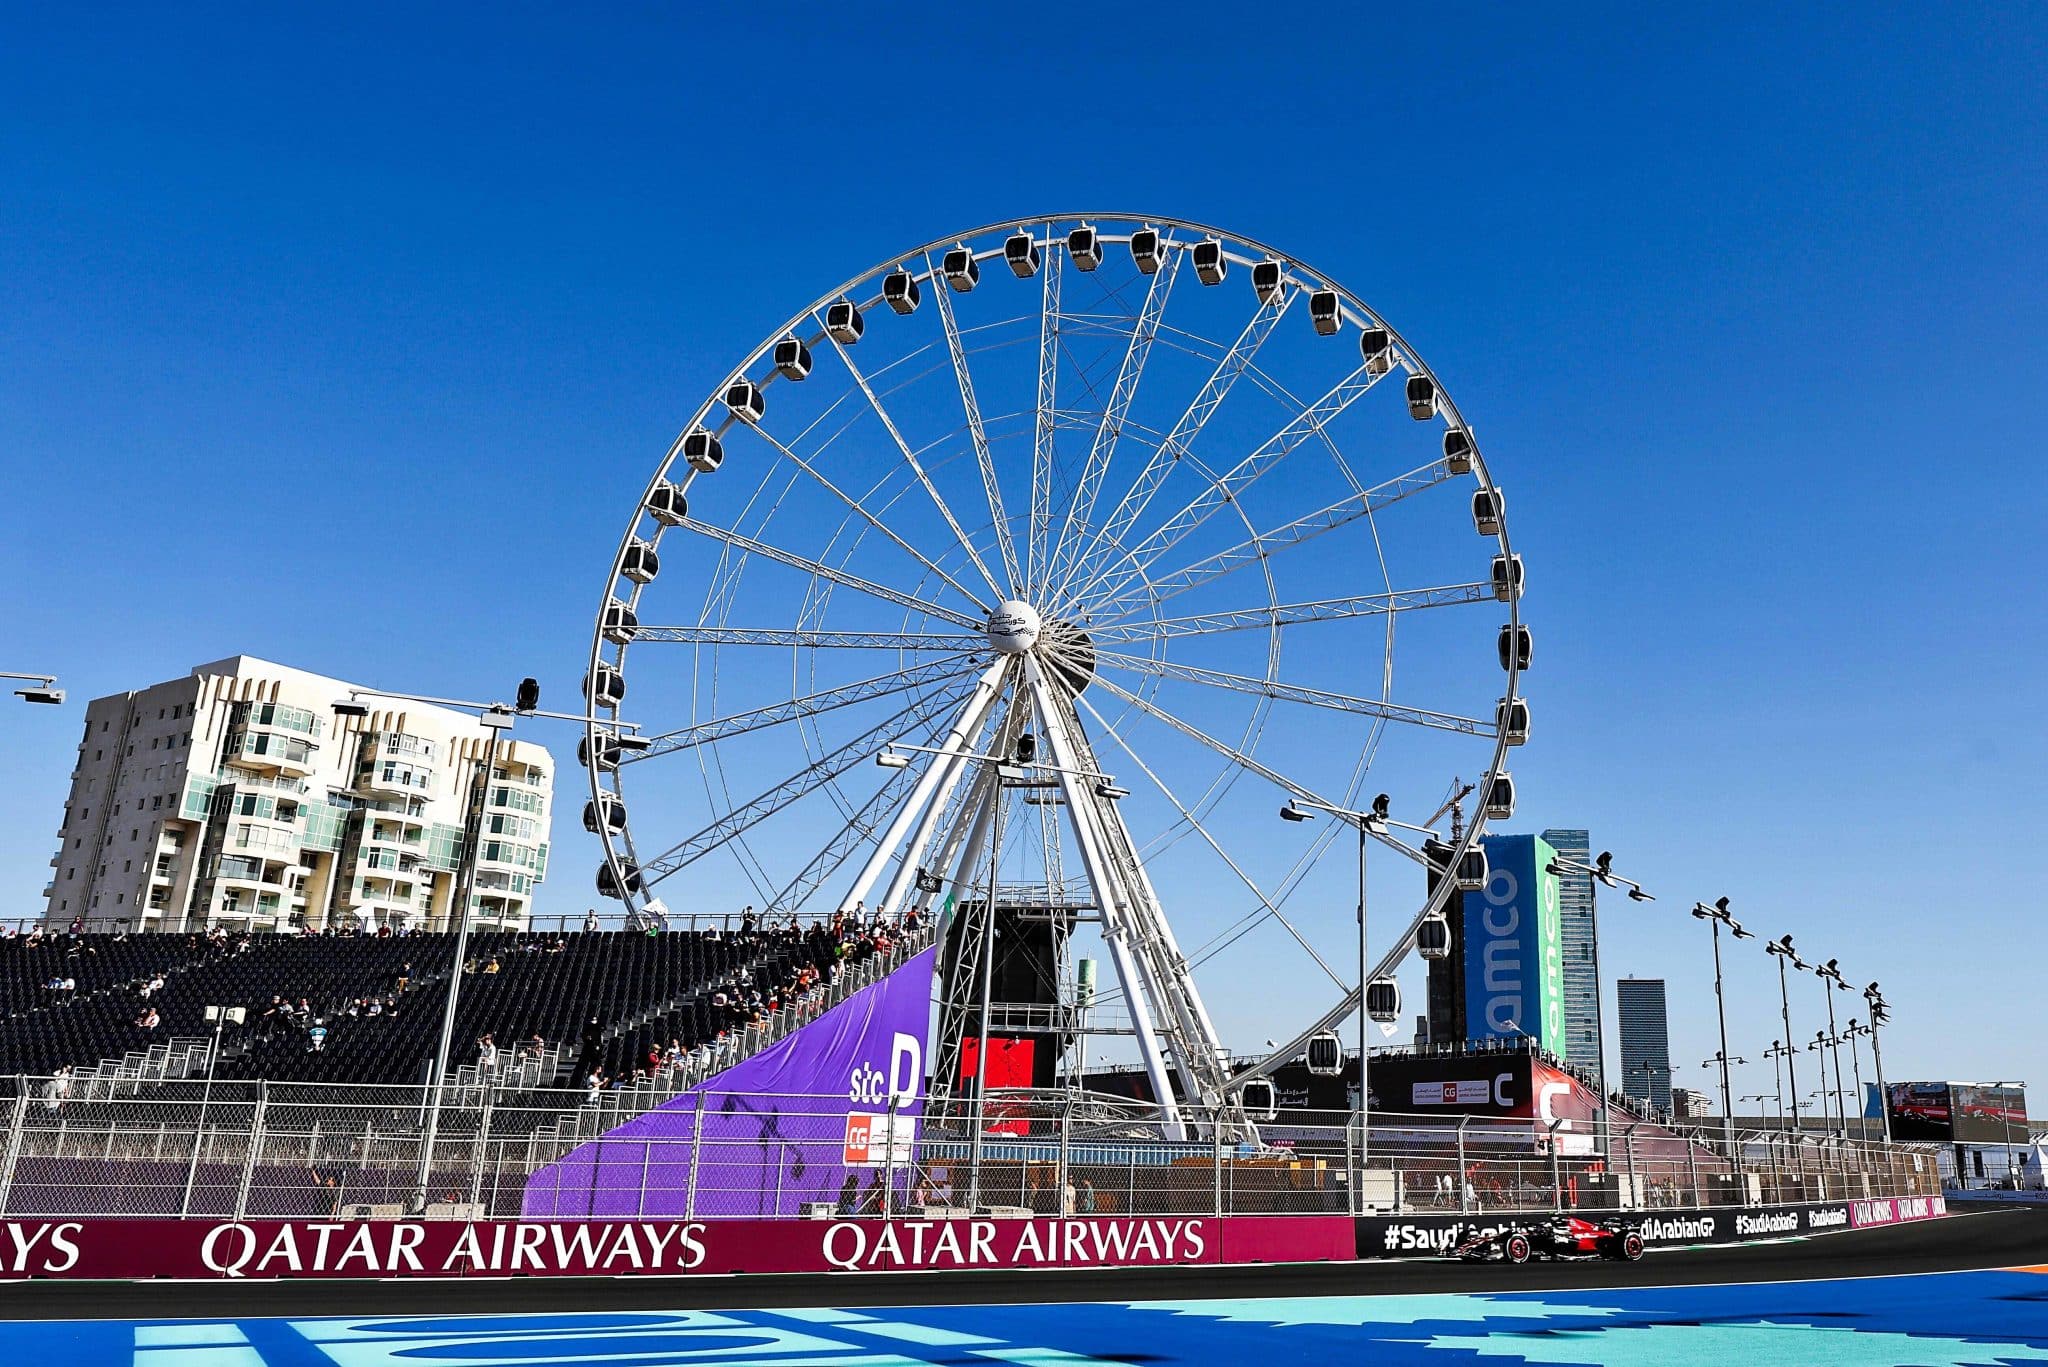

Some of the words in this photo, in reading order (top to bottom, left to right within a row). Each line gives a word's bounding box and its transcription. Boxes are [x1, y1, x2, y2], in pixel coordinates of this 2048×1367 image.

[1482, 868, 1522, 1040] amco
[849, 1061, 884, 1105] stc
[888, 1031, 921, 1109] D
[1494, 1073, 1514, 1106] C
[1539, 1082, 1573, 1131] C
[849, 1126, 868, 1150] CG
[0, 1222, 83, 1272] YS
[201, 1223, 425, 1278] QATAR
[441, 1222, 707, 1270] AIRWAYS
[822, 1221, 999, 1271] QATAR
[1011, 1220, 1205, 1262] AIRWAYS
